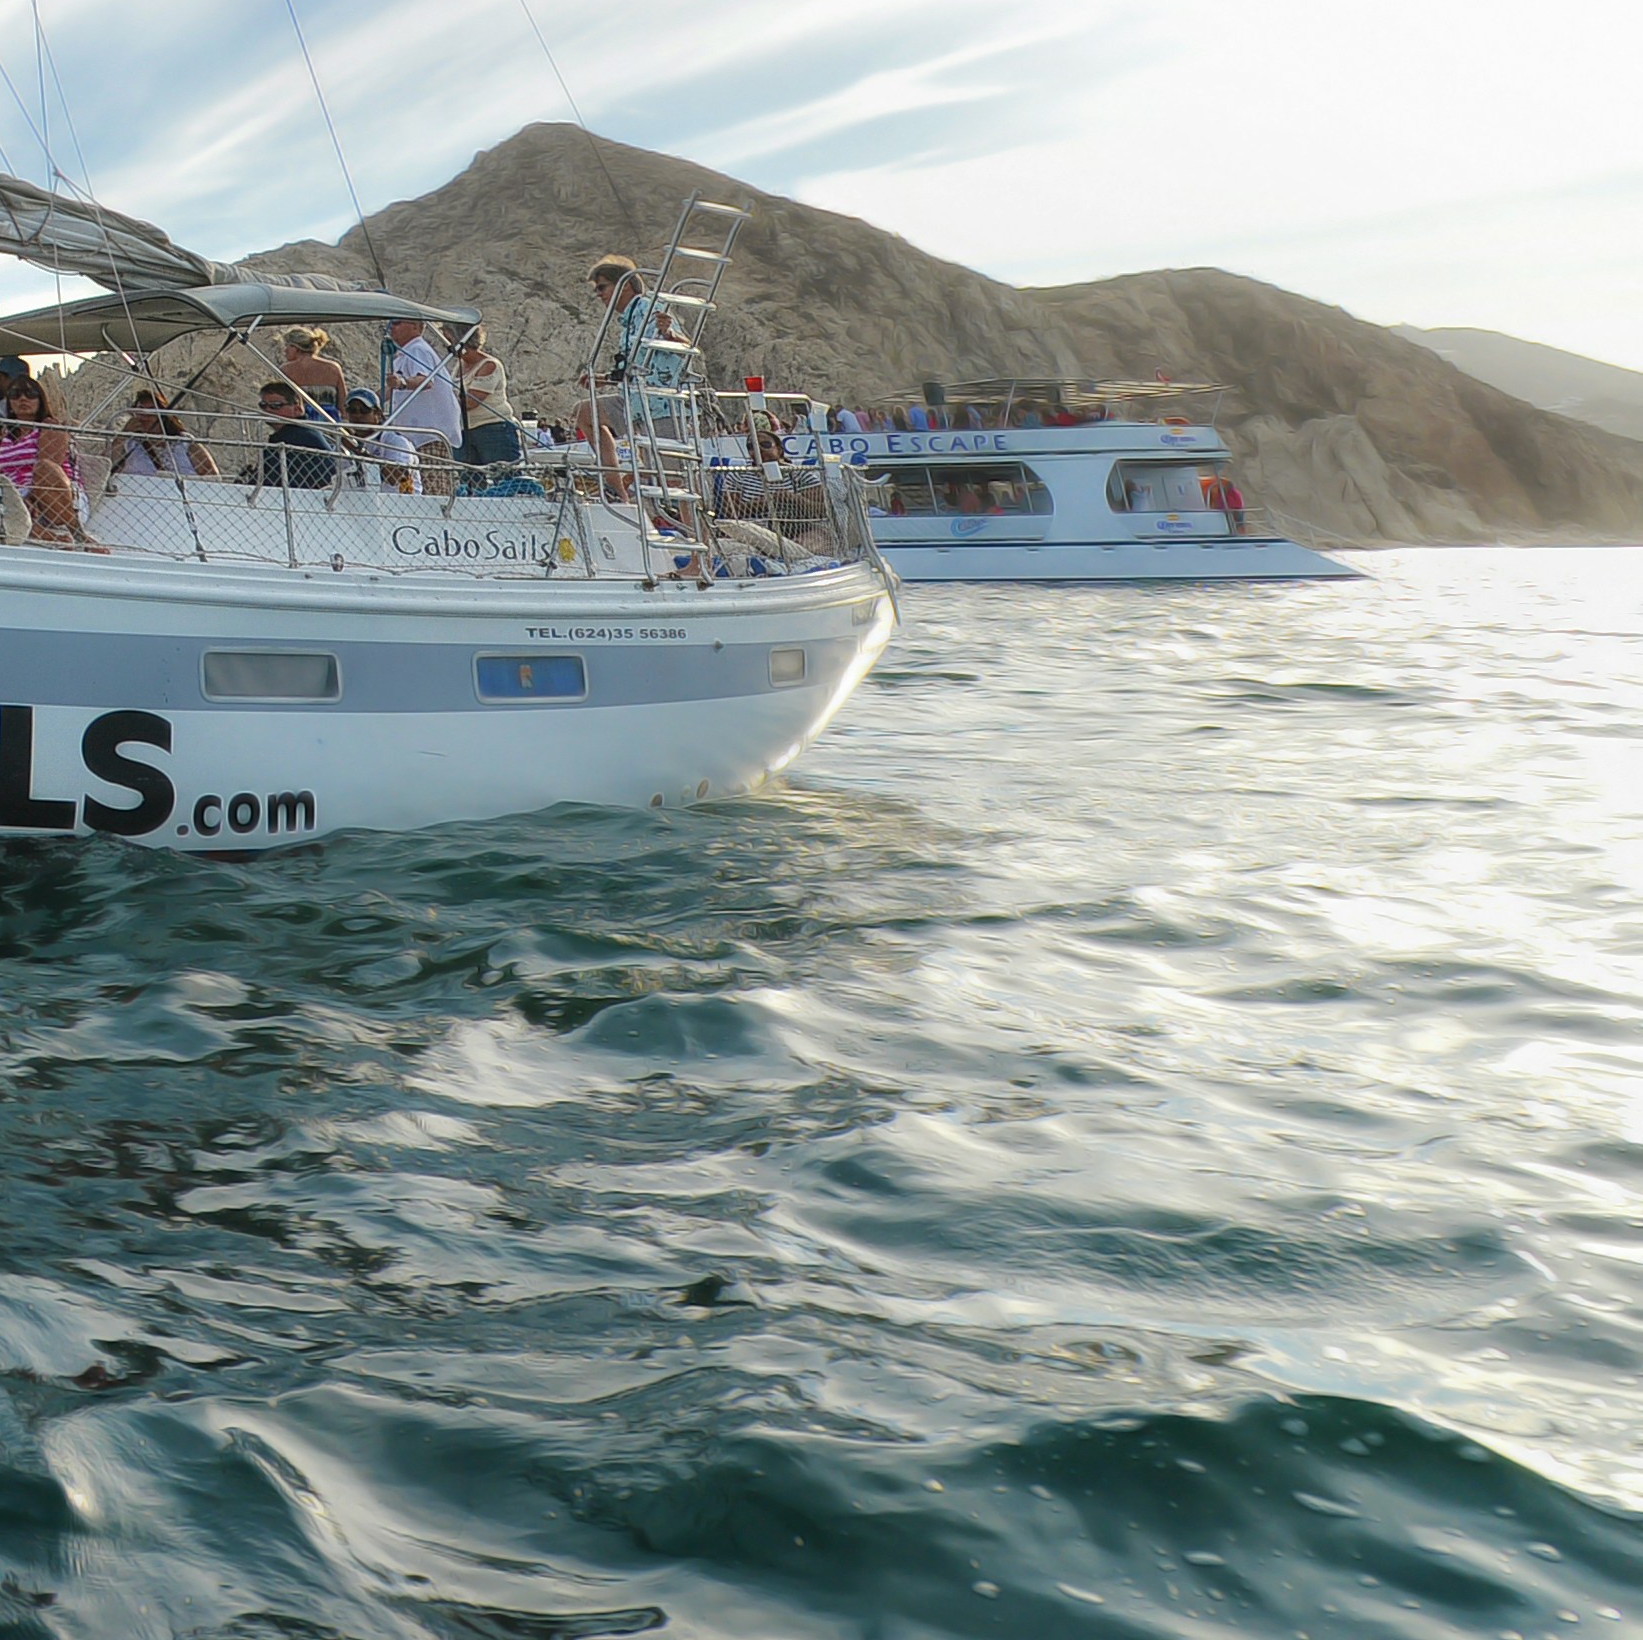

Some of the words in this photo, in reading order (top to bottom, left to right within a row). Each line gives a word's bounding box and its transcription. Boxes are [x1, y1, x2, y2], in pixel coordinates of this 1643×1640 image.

[782, 436, 869, 456] CABO
[887, 434, 1008, 453] ESCAPE
[639, 628, 686, 640] 56386
